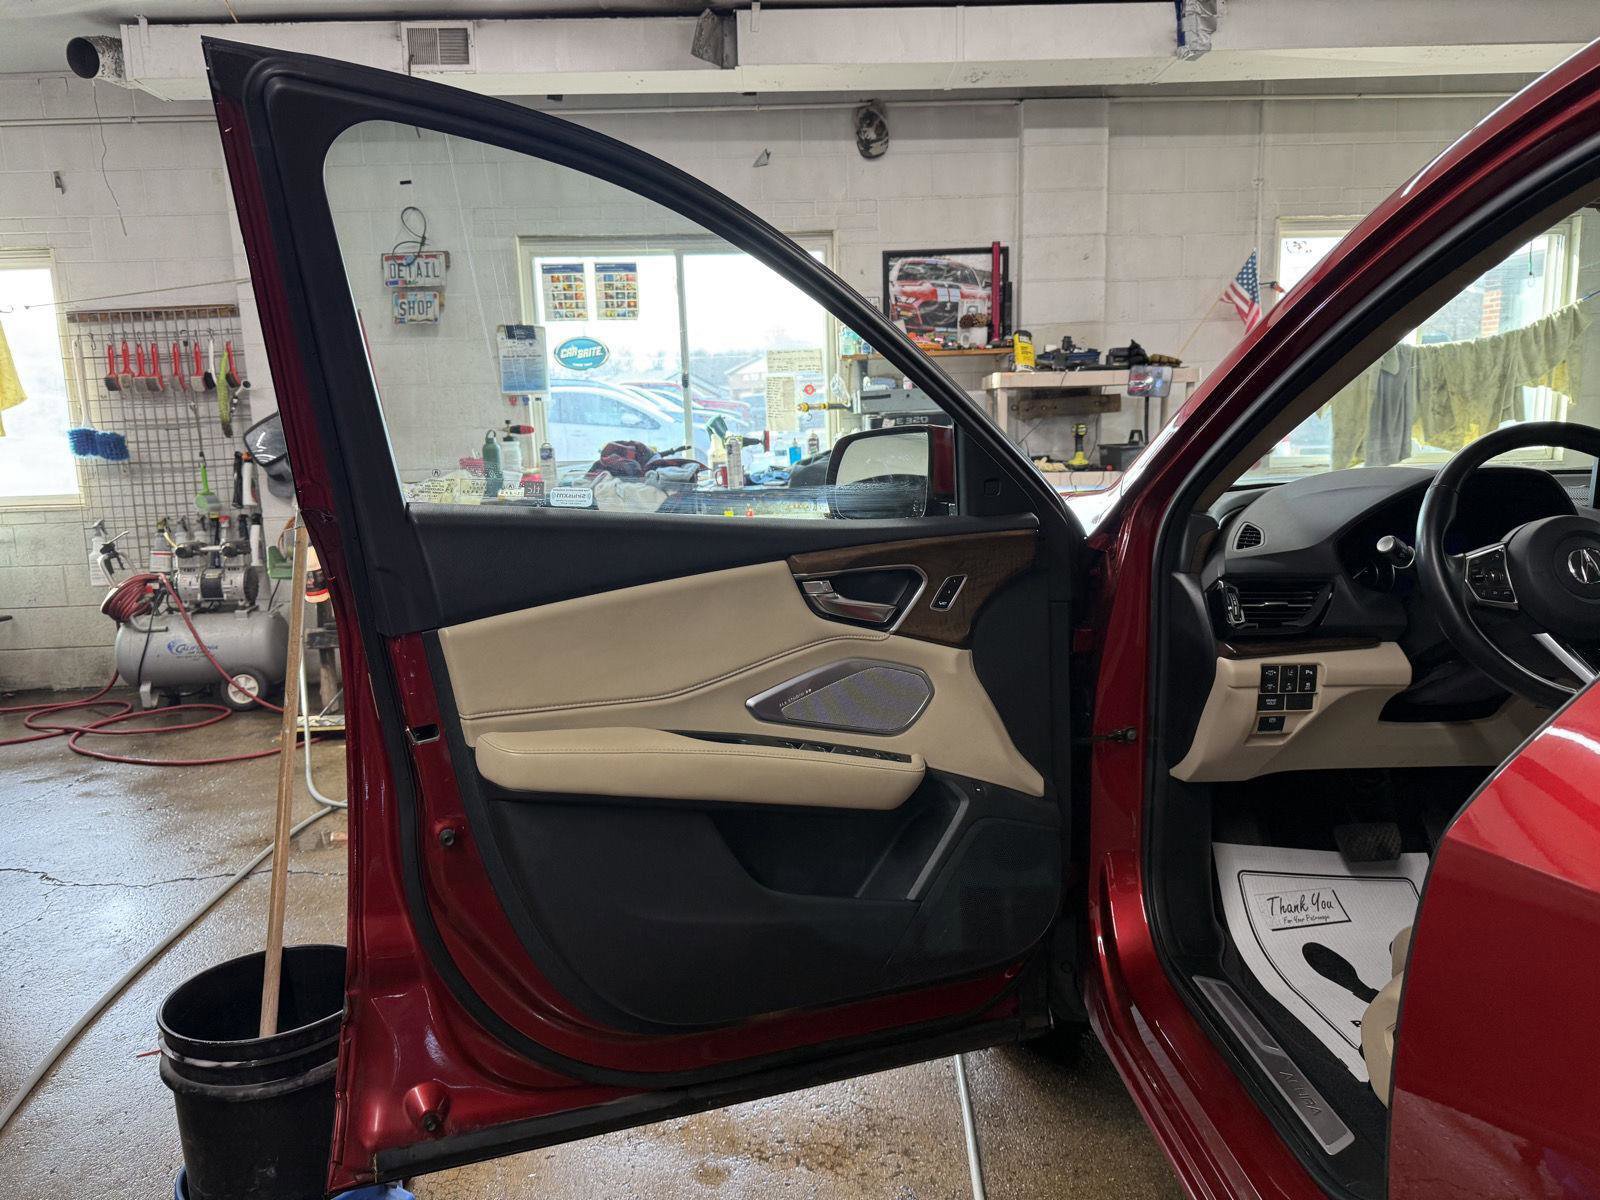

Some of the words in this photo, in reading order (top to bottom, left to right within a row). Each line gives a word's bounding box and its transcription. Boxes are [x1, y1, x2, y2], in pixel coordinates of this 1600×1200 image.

[389, 261, 440, 279] DETAIL
[399, 300, 433, 317] SHOP
[896, 417, 904, 425] E
[905, 416, 929, 425] 320
[1266, 894, 1309, 916] Thank
[1311, 892, 1334, 912] You
